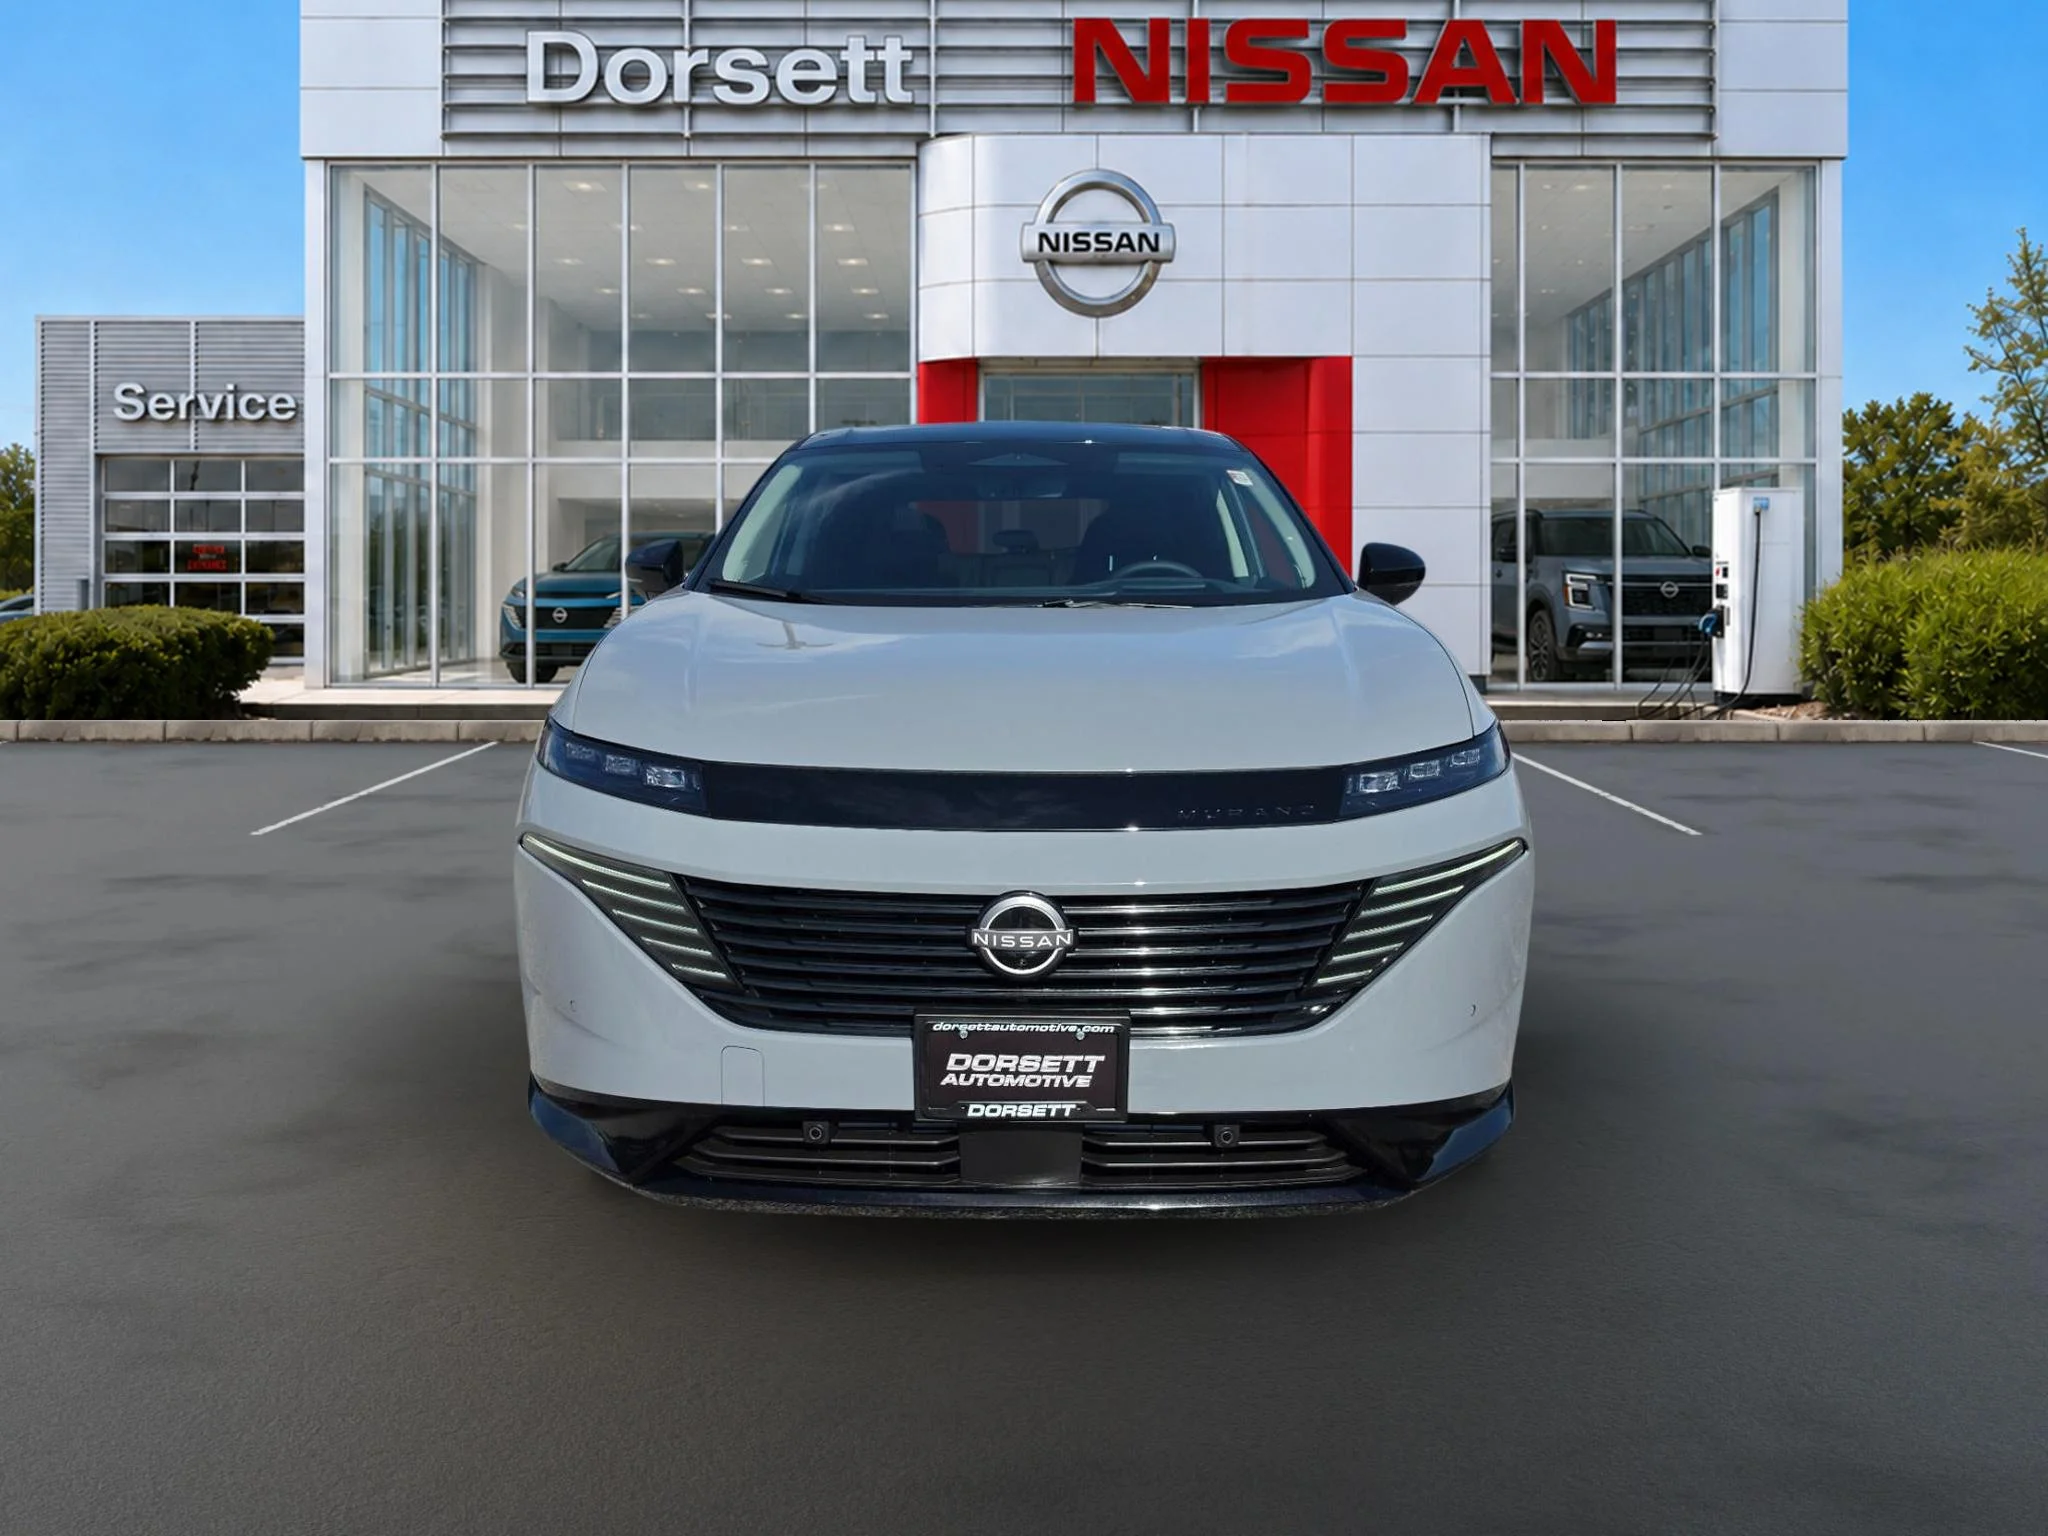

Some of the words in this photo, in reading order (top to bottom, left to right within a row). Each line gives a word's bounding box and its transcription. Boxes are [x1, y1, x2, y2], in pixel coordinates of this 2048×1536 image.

[526, 30, 914, 106] Dorsett
[1073, 17, 1617, 104] NISSAN
[1038, 232, 1160, 253] NISSAN
[113, 382, 297, 421] Service
[973, 932, 1071, 948] NISSAN
[932, 1022, 1115, 1033] dorsettautomotive.com
[946, 1053, 1106, 1072] DORSETT
[940, 1073, 1093, 1088] AUTOMOTIVE
[967, 1104, 1077, 1118] DORSETT
